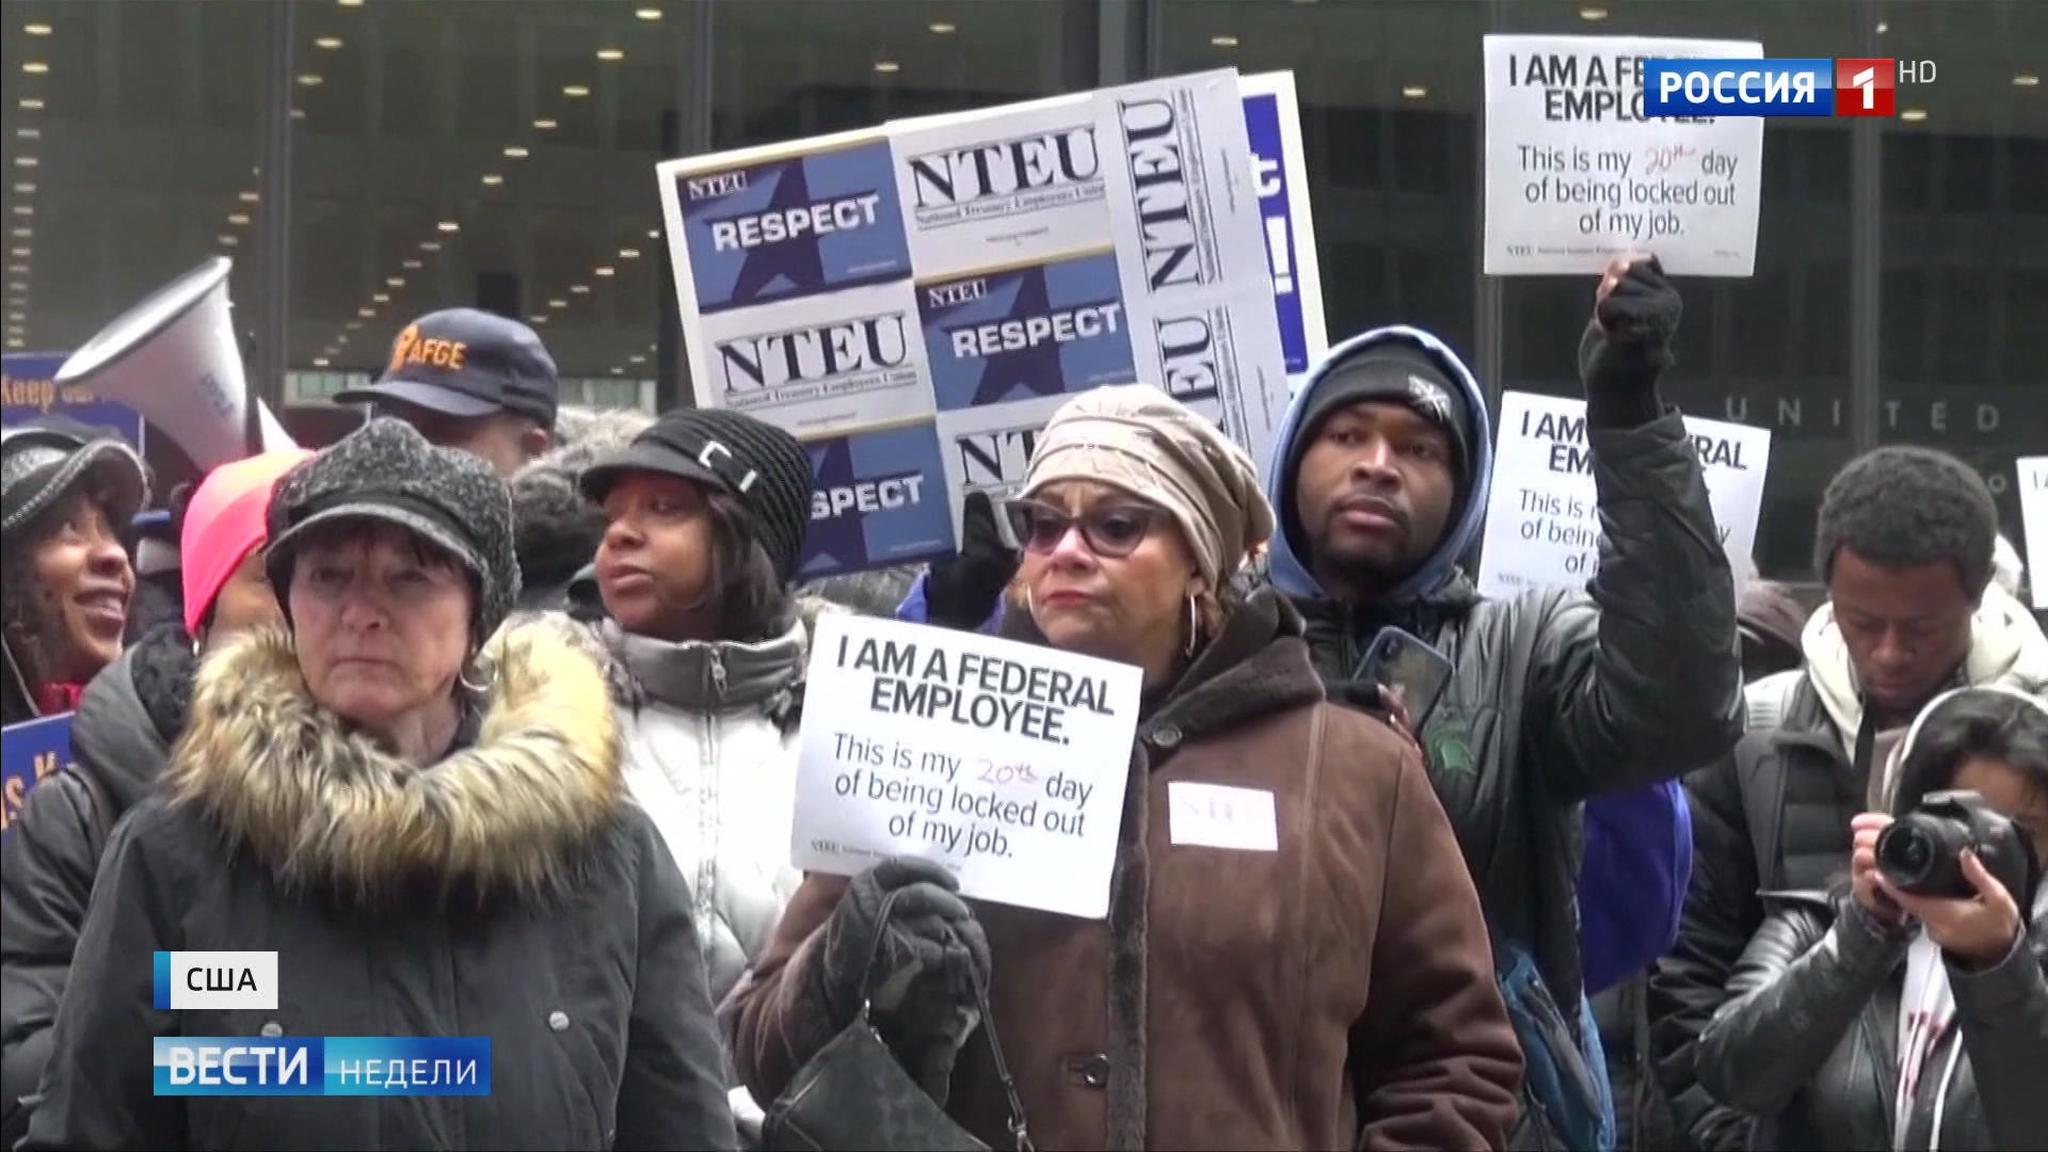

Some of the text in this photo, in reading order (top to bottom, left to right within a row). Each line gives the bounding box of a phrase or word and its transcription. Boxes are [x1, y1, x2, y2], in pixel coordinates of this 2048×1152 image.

[1509, 53, 1517, 86] I
[1525, 53, 1577, 87] AM
[1585, 54, 1608, 87] A
[908, 127, 1098, 207] NTEU
[1518, 145, 1565, 172] This
[1573, 146, 1590, 172] is
[1598, 152, 1631, 178] my
[1701, 150, 1738, 179] day
[687, 170, 748, 200] NTEU
[1122, 99, 1200, 292] NTEU
[1525, 176, 1736, 209] of being locked out
[712, 194, 879, 252] RESPECT
[1579, 207, 1685, 240] of my job.
[928, 278, 987, 309] NTEU
[952, 302, 1121, 358] RESPECT
[718, 315, 907, 391] NTEU
[1521, 410, 1585, 444] I AM
[1725, 396, 2000, 431] UNITED
[956, 431, 1036, 485] NT
[810, 475, 924, 520] SPECT
[1520, 488, 1560, 517] This
[1567, 495, 1583, 517] is
[1520, 518, 1542, 541] of
[1565, 553, 1586, 575] of
[837, 635, 1115, 716] I AM A FEDERAL
[870, 676, 1070, 745] EMPLOYEE.
[833, 732, 883, 766] This
[893, 742, 912, 769] is
[921, 751, 961, 783] my
[1045, 771, 1093, 810] day
[835, 769, 1085, 837] of being locked out
[889, 810, 1013, 858] of my job.
